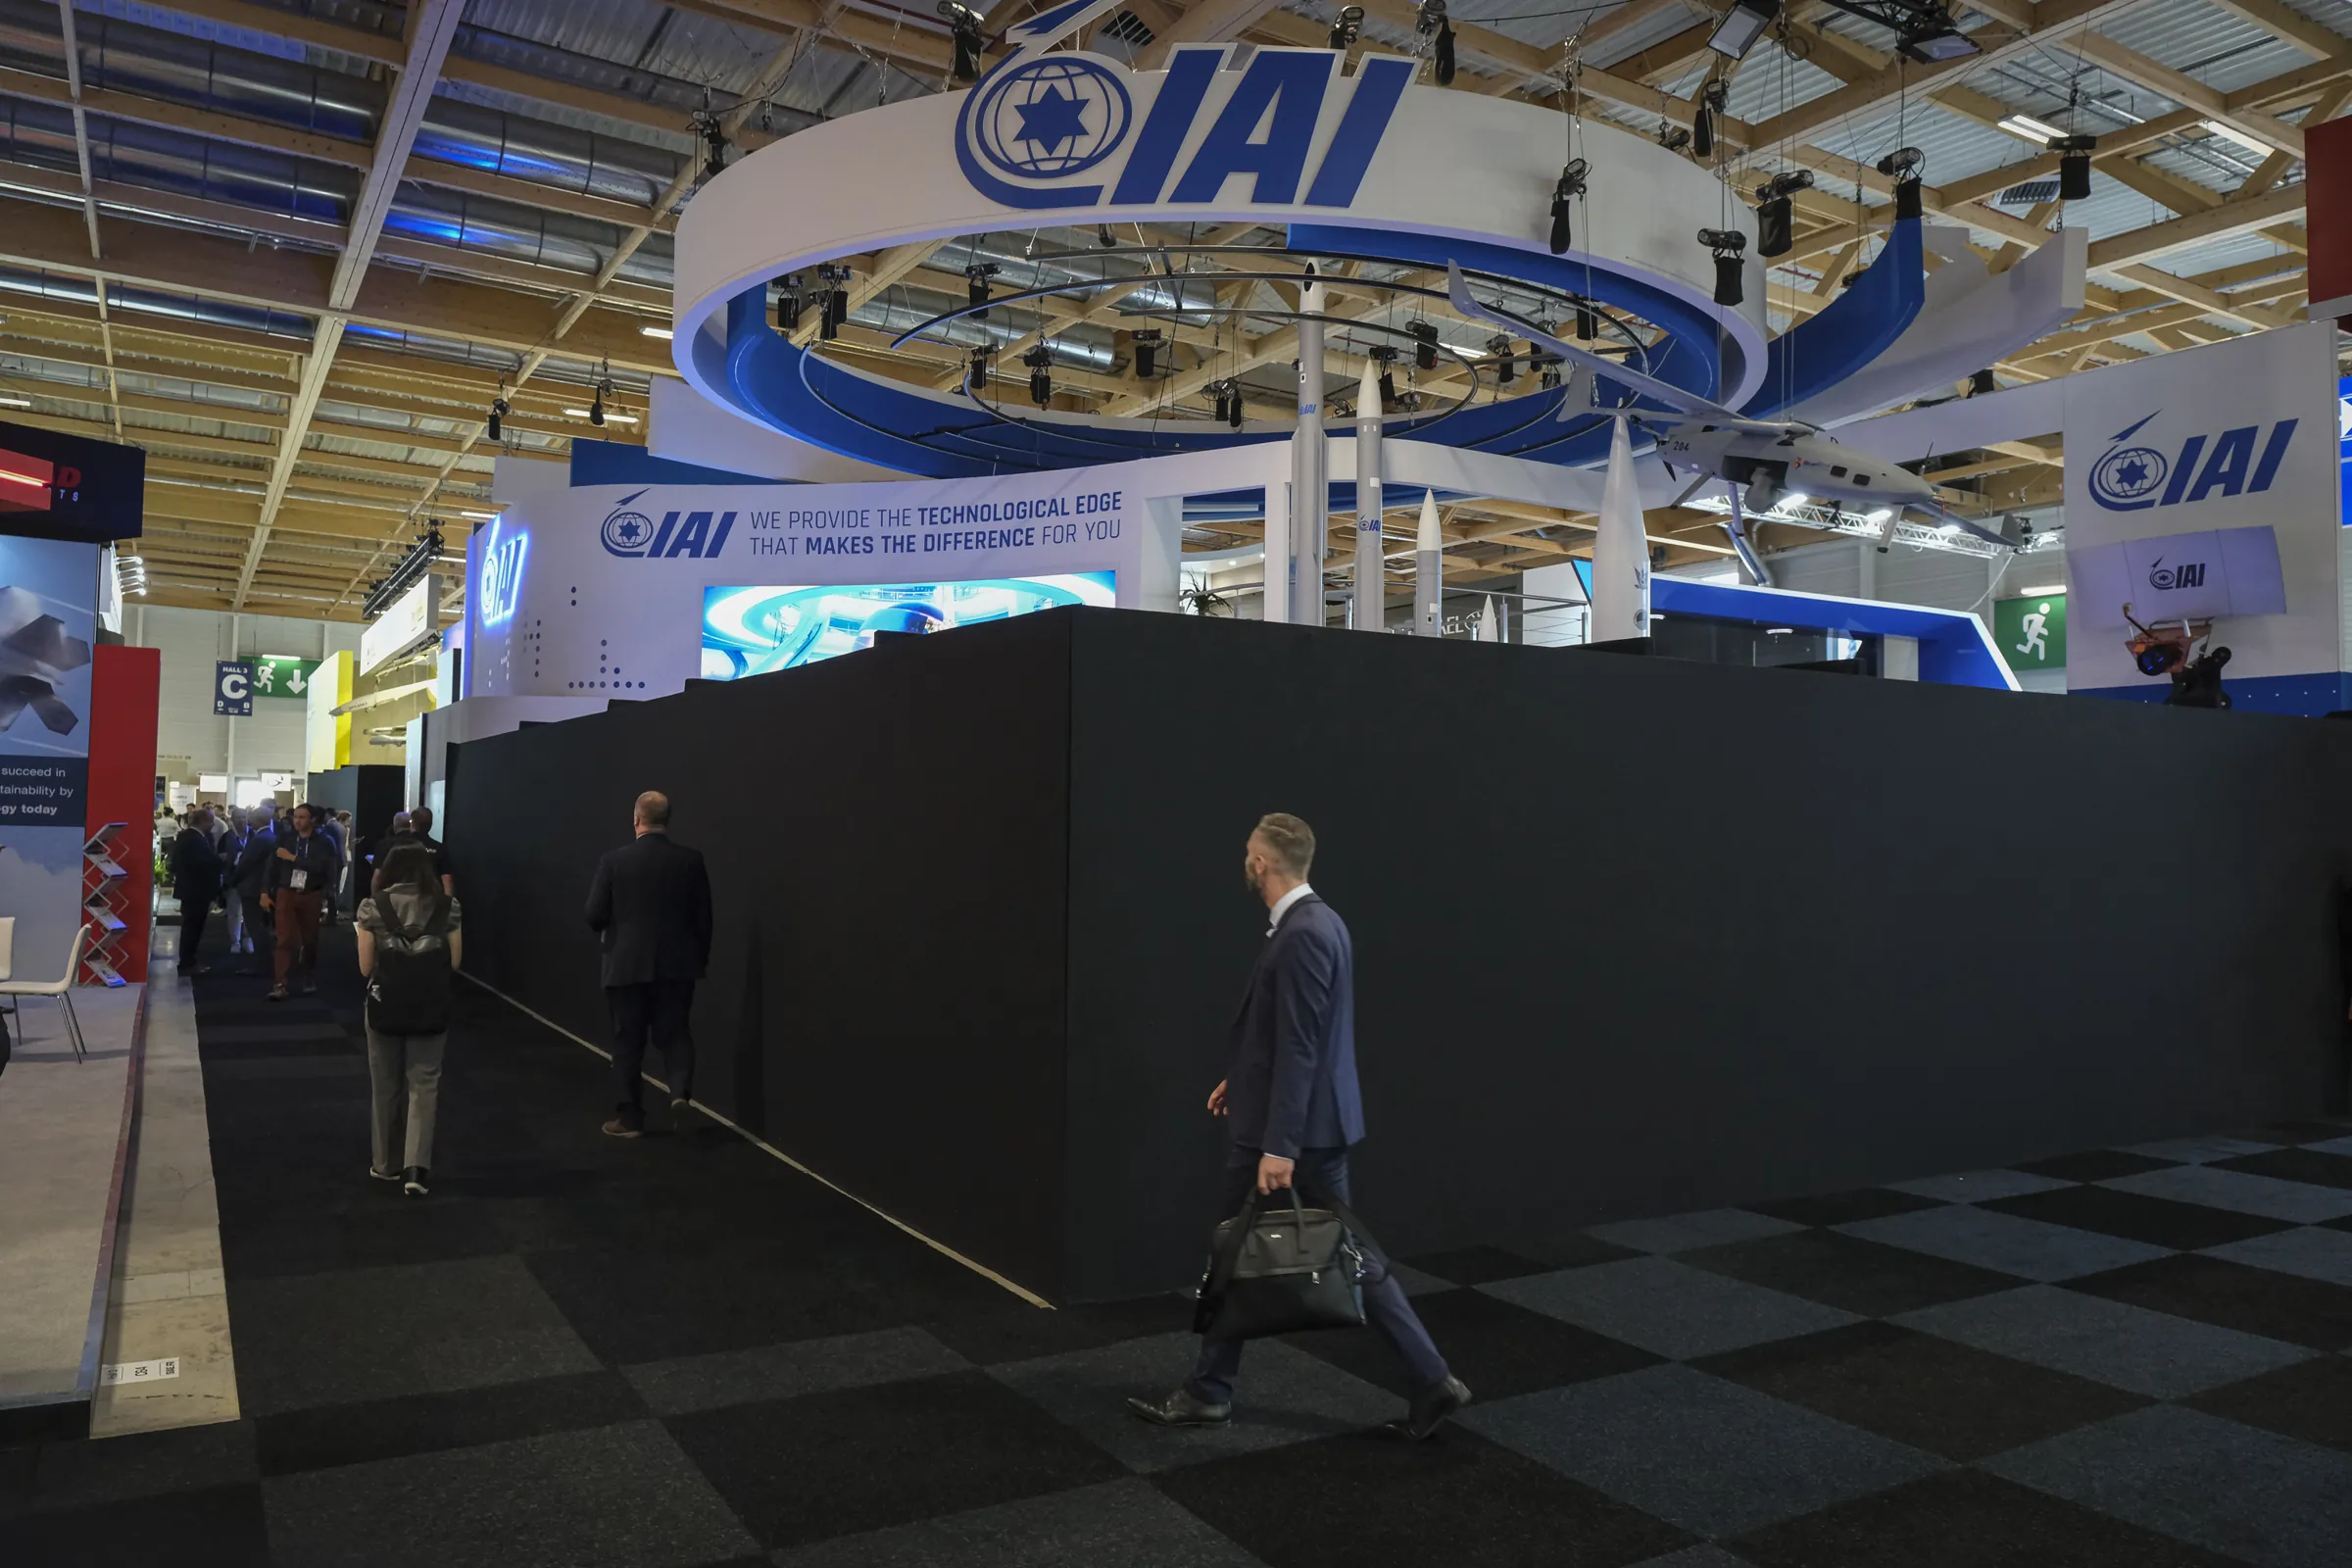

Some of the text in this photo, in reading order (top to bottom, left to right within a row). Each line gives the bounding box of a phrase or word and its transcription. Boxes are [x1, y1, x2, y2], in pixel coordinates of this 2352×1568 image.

[1109, 49, 1414, 208] IAI
[1674, 441, 1690, 452] 204
[2159, 418, 2299, 507] IAI
[751, 491, 1122, 529] WE PROVIDE THE TECHNOLOGICAL EDGE
[647, 511, 738, 559] IAI
[750, 518, 1121, 556] THAT MAKES THE DIFFERENCE FOR YOU
[2176, 563, 2206, 589] IAI
[221, 674, 248, 700] C
[1, 767, 66, 777] succeed in
[0, 785, 74, 798] tainability by
[0, 804, 58, 815] gy today
